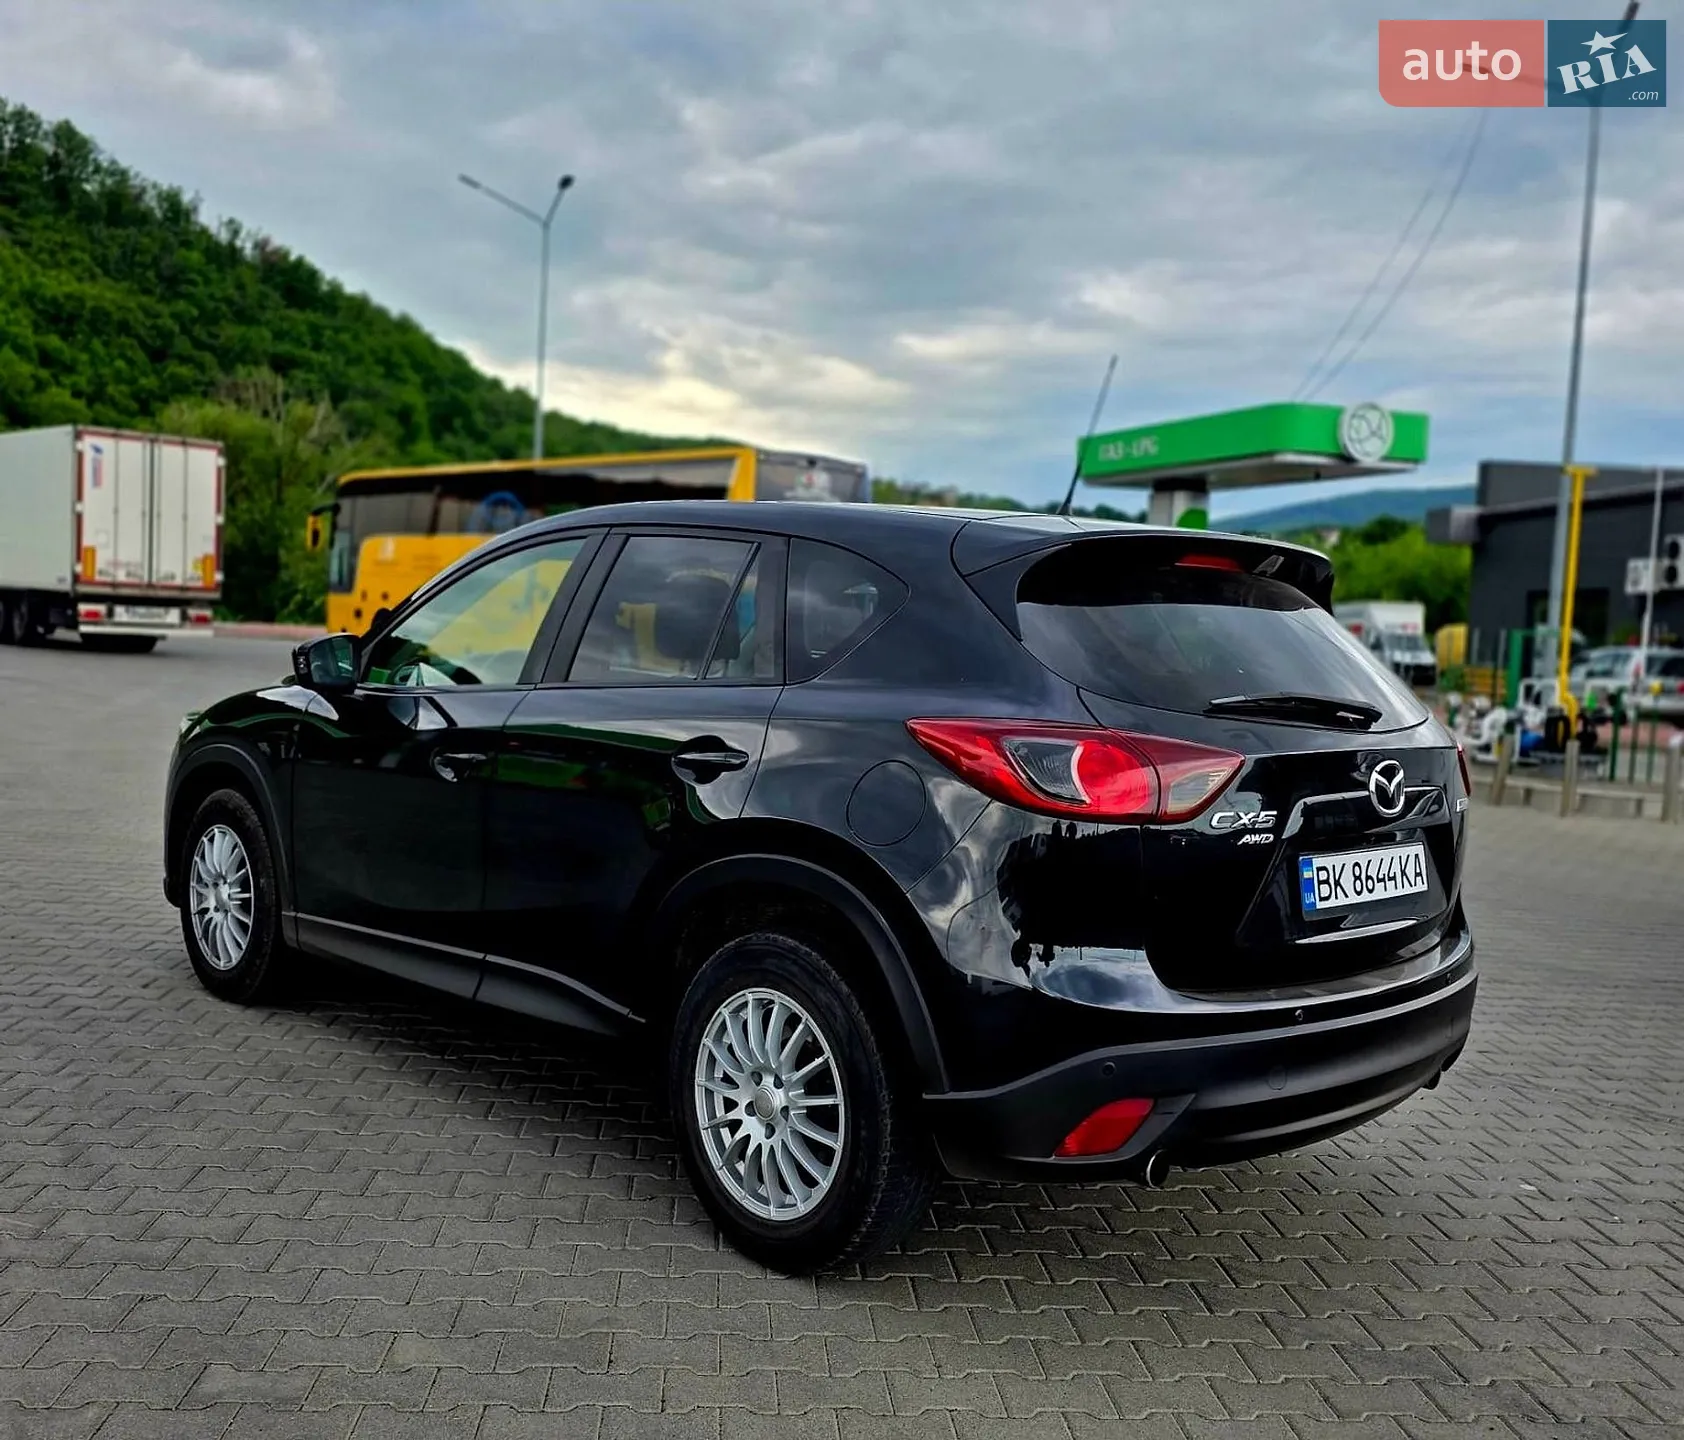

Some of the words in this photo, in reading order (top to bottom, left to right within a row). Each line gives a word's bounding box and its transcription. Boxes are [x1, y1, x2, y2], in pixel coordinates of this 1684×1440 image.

[1237, 833, 1275, 846] AWD
[1315, 862, 1349, 902] BK
[1305, 892, 1316, 904] UA
